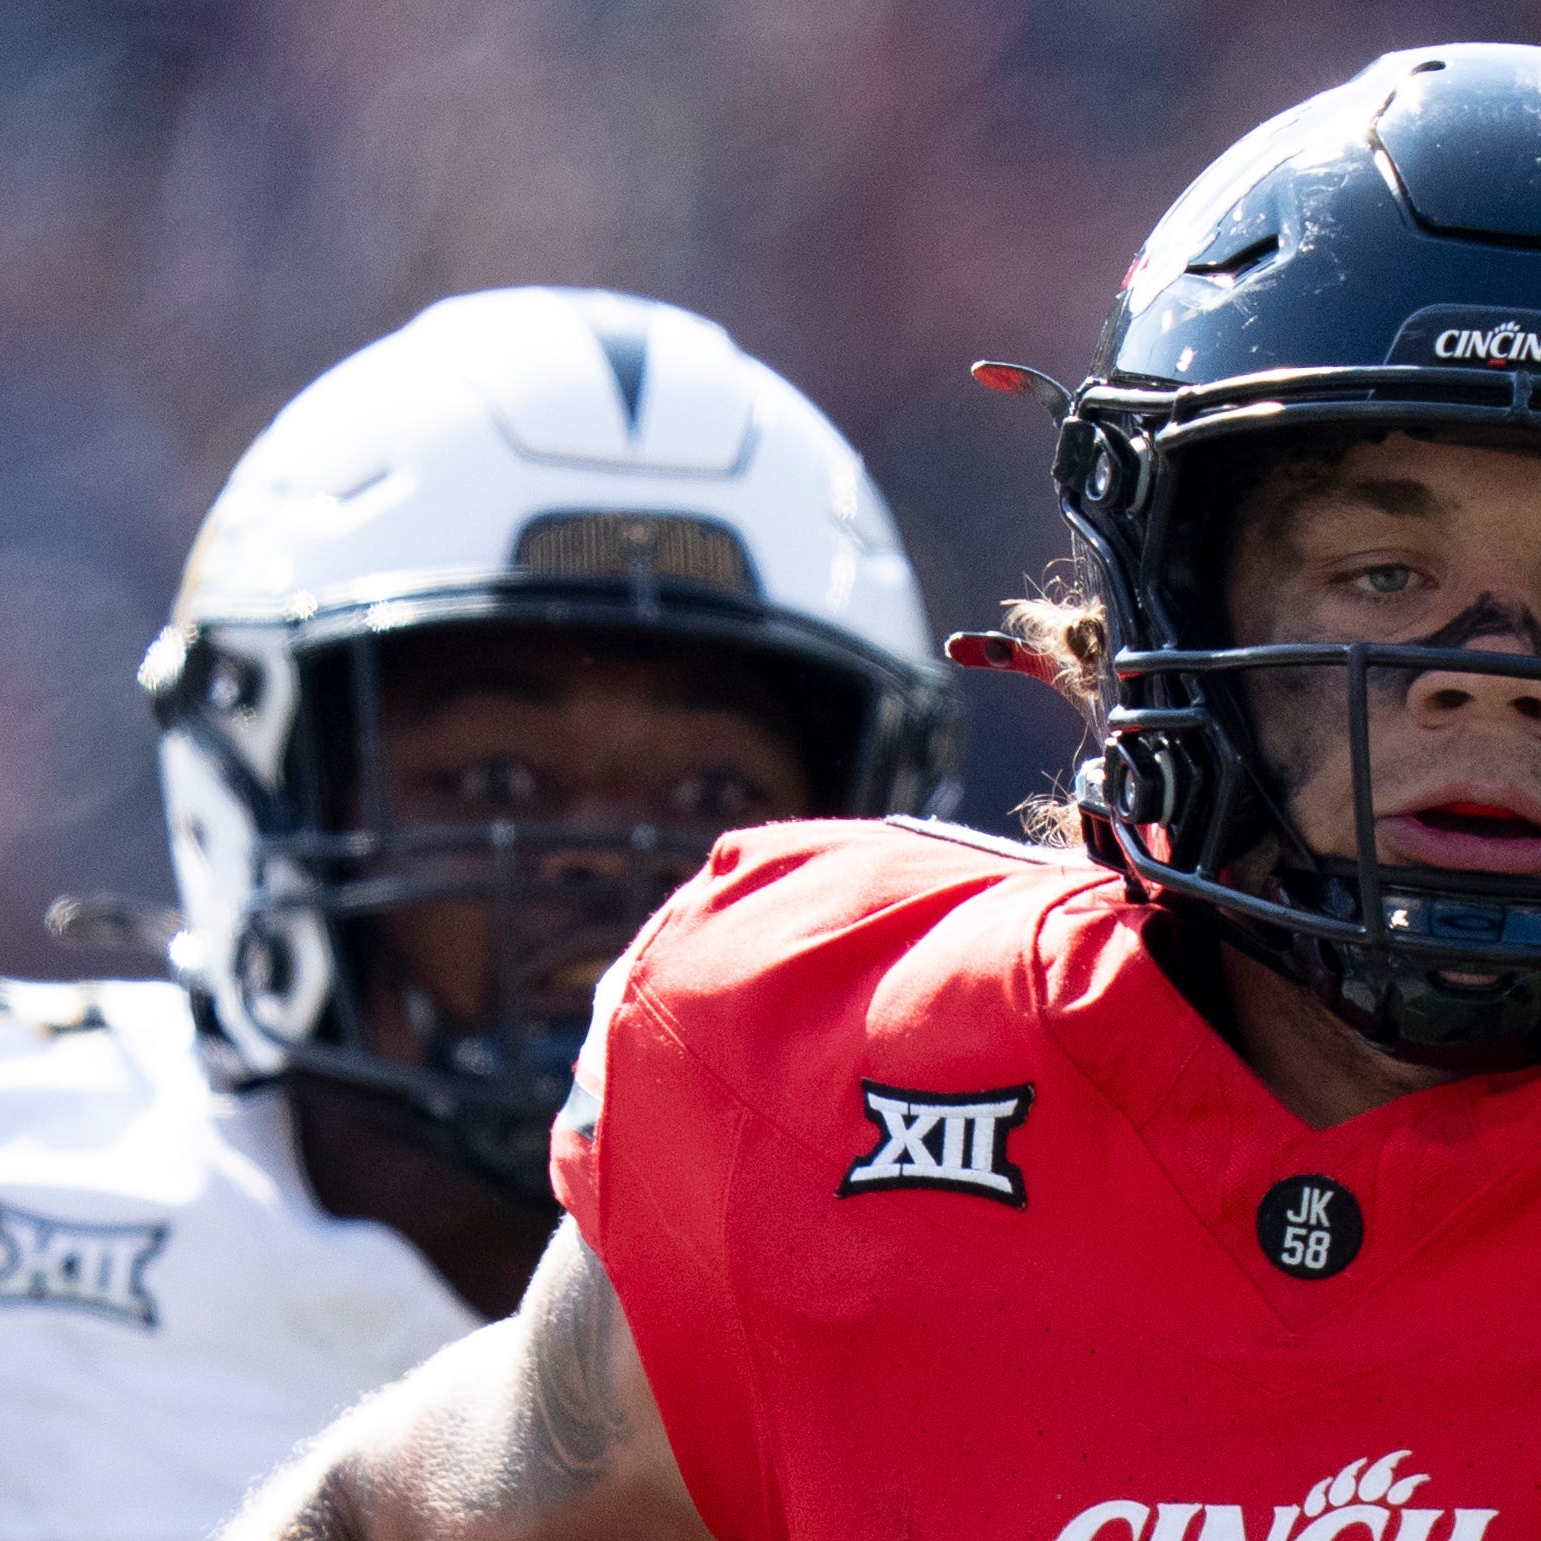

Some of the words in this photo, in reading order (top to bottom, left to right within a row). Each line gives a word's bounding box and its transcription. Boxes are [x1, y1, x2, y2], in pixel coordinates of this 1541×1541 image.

[848, 1091, 1020, 1195] XII
[1285, 1186, 1335, 1228] JK
[1280, 1226, 1332, 1269] 58
